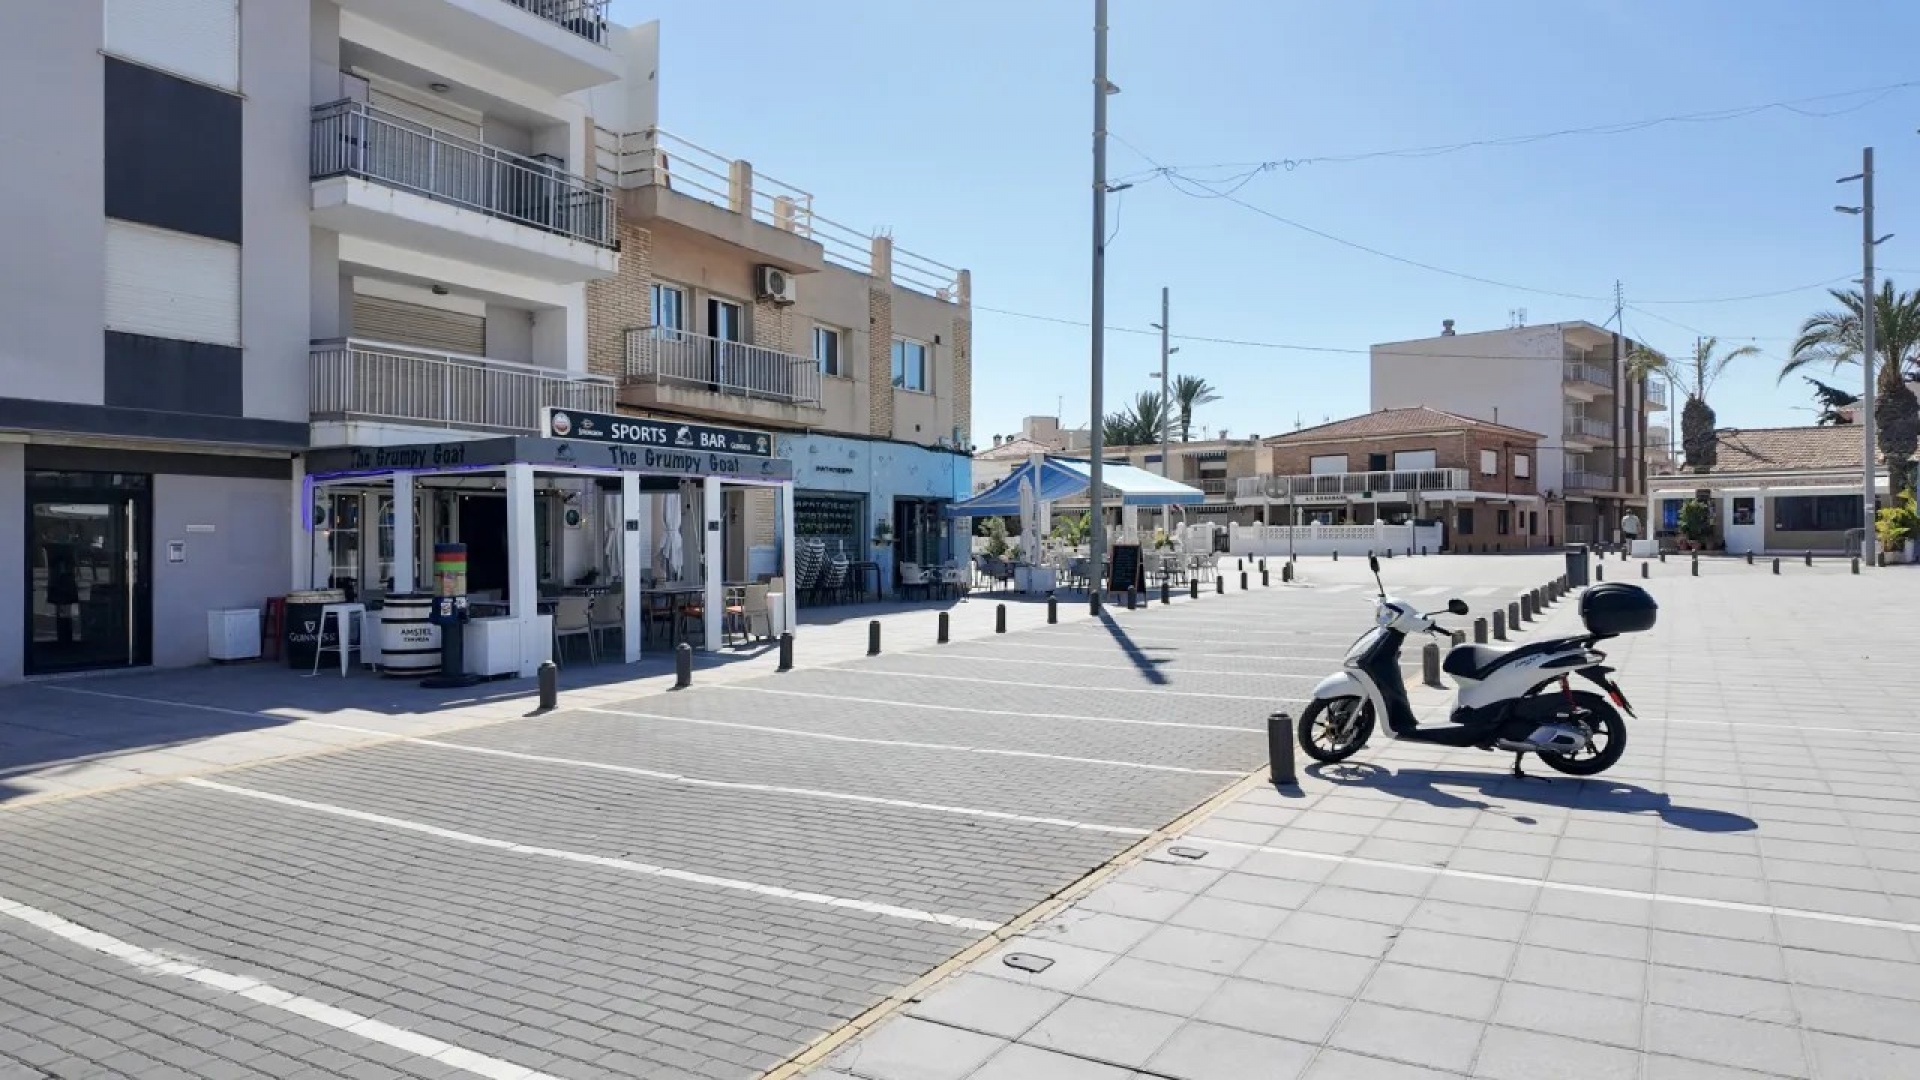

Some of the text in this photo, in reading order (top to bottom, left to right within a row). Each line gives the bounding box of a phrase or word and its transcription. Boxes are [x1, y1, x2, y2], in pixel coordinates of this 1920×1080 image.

[611, 423, 667, 443] SPORTS
[700, 431, 726, 449] BAR
[350, 443, 465, 469] The Grumpy Goat
[608, 445, 739, 474] The Grumpy Goat
[401, 628, 432, 637] AMSTEL
